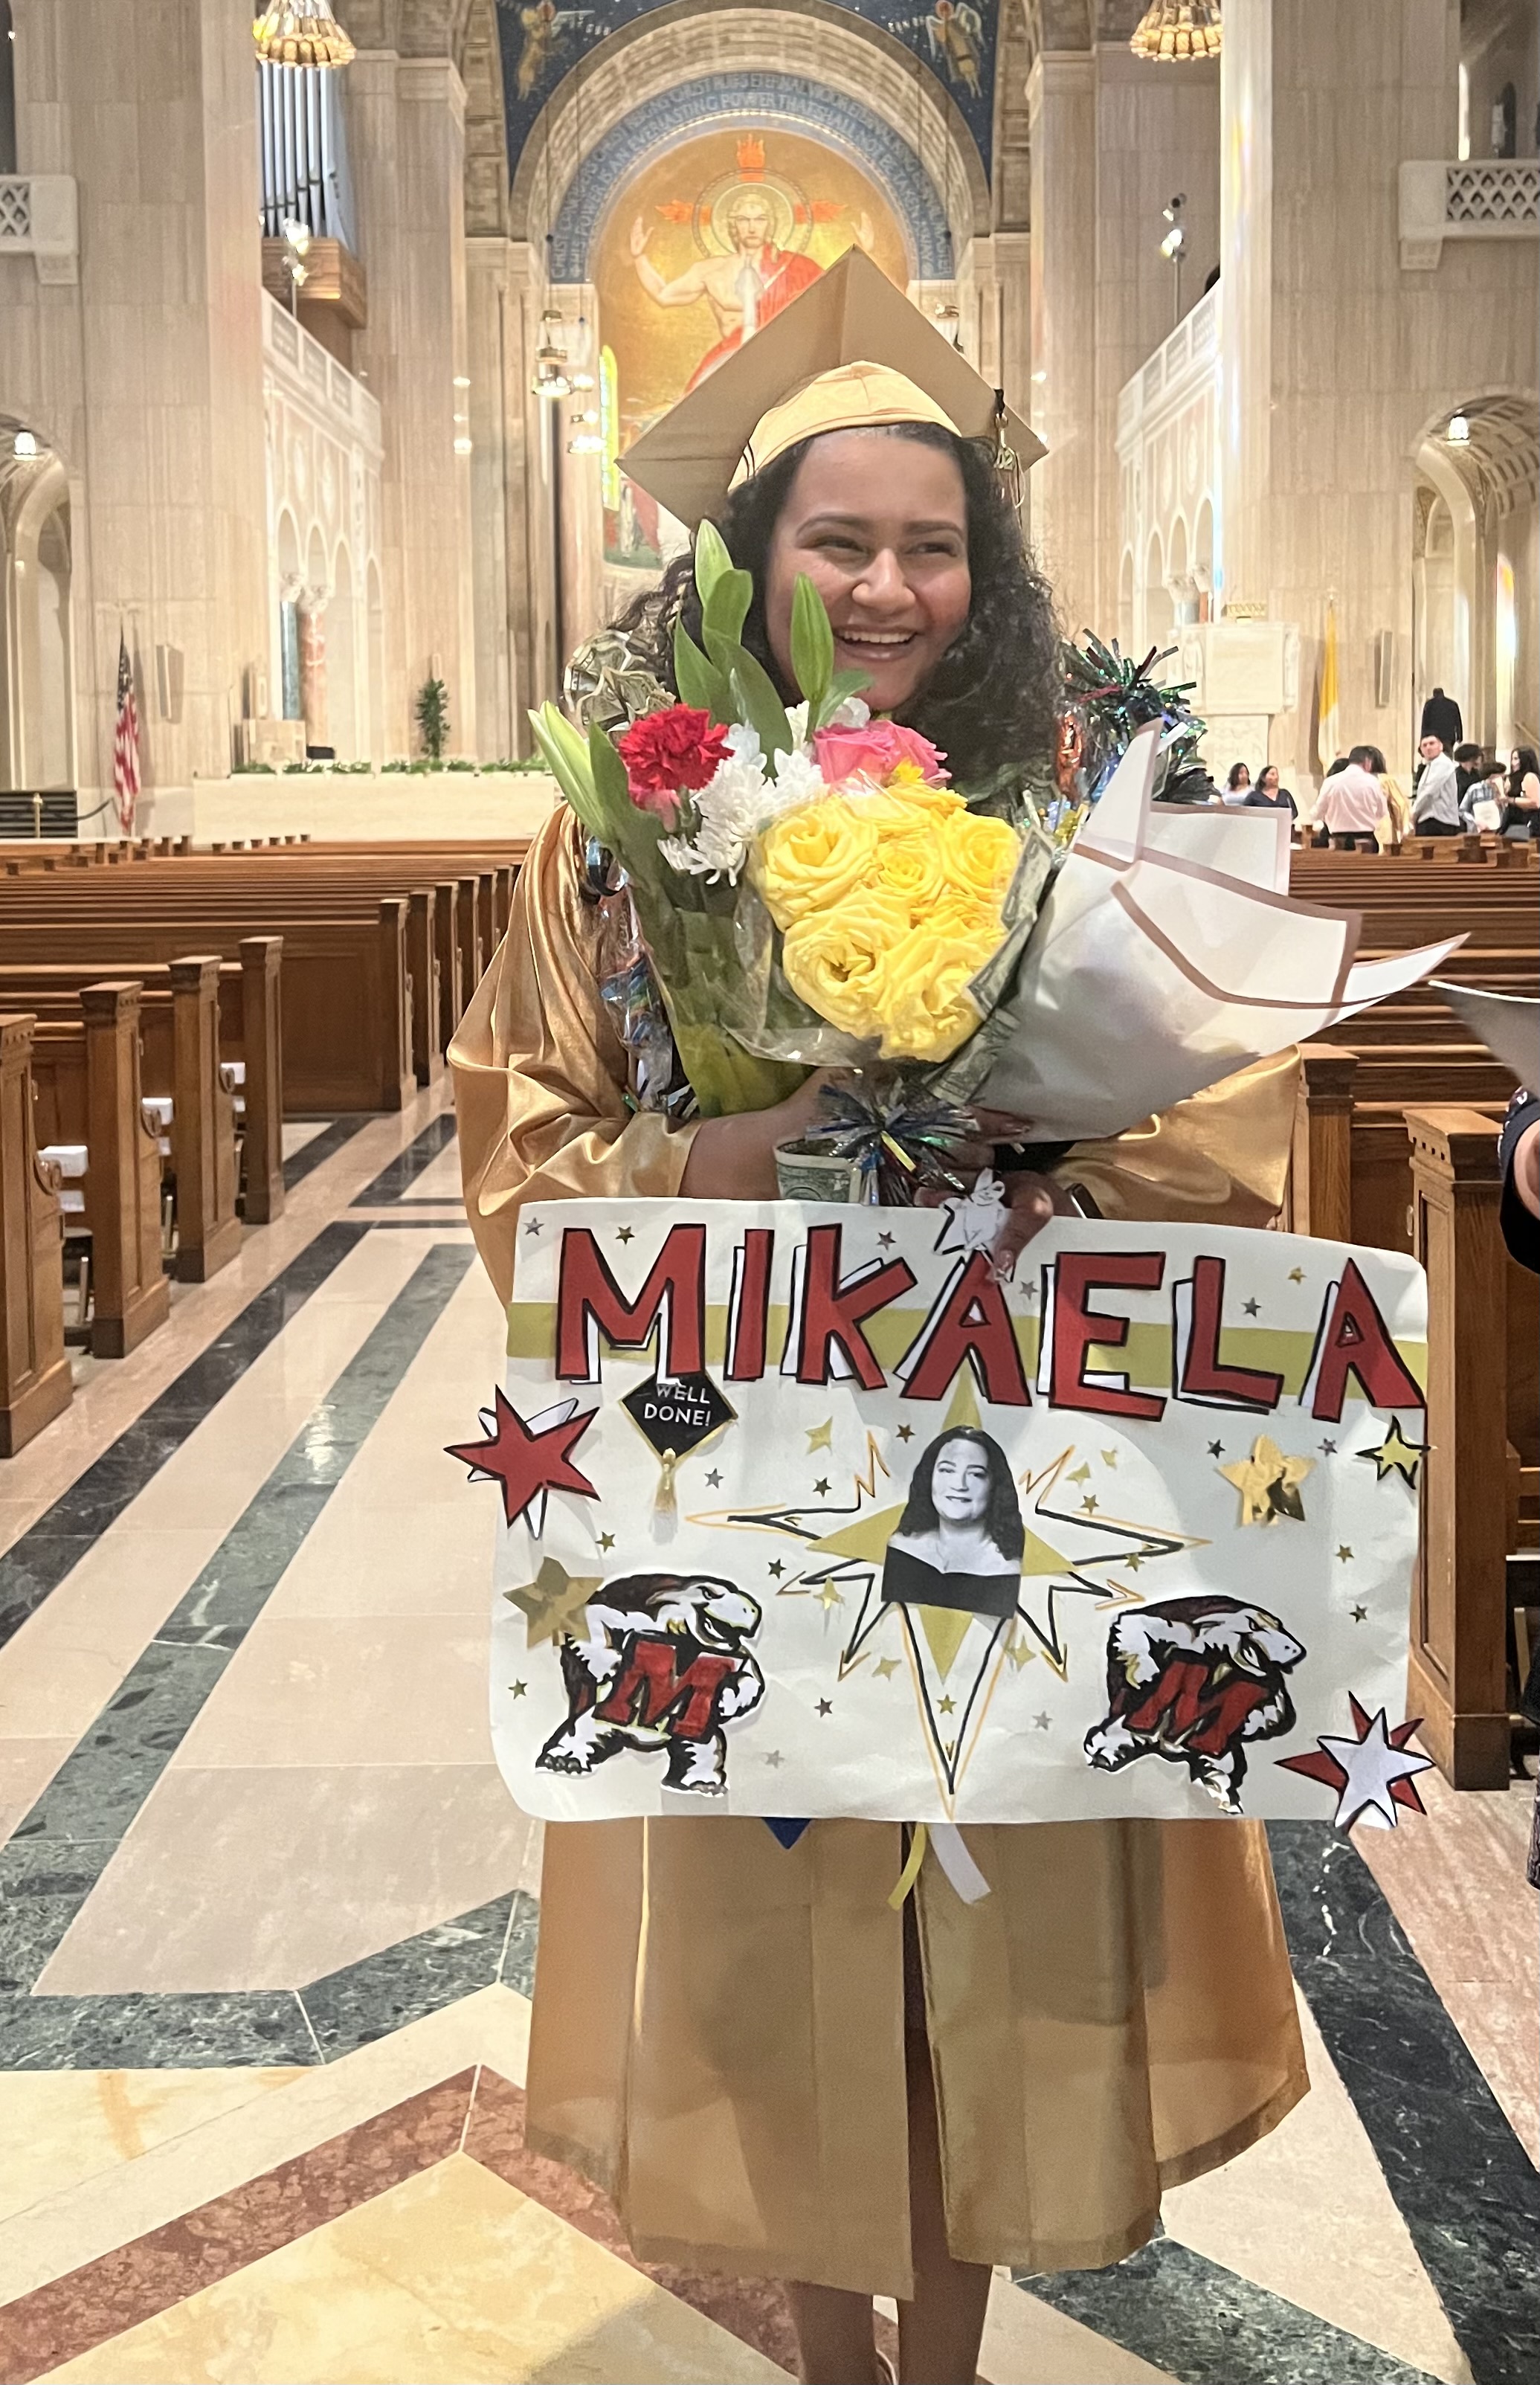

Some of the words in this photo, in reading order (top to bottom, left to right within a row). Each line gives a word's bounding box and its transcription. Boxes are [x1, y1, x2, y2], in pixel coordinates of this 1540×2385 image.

[573, 181, 607, 236] POWER
[604, 146, 632, 175] AN
[854, 128, 885, 158] NOT
[555, 1223, 1427, 1422] MIKAELA
[644, 1403, 711, 1426] DONE!
[657, 1383, 710, 1404] WELL
[592, 1636, 739, 1741] M
